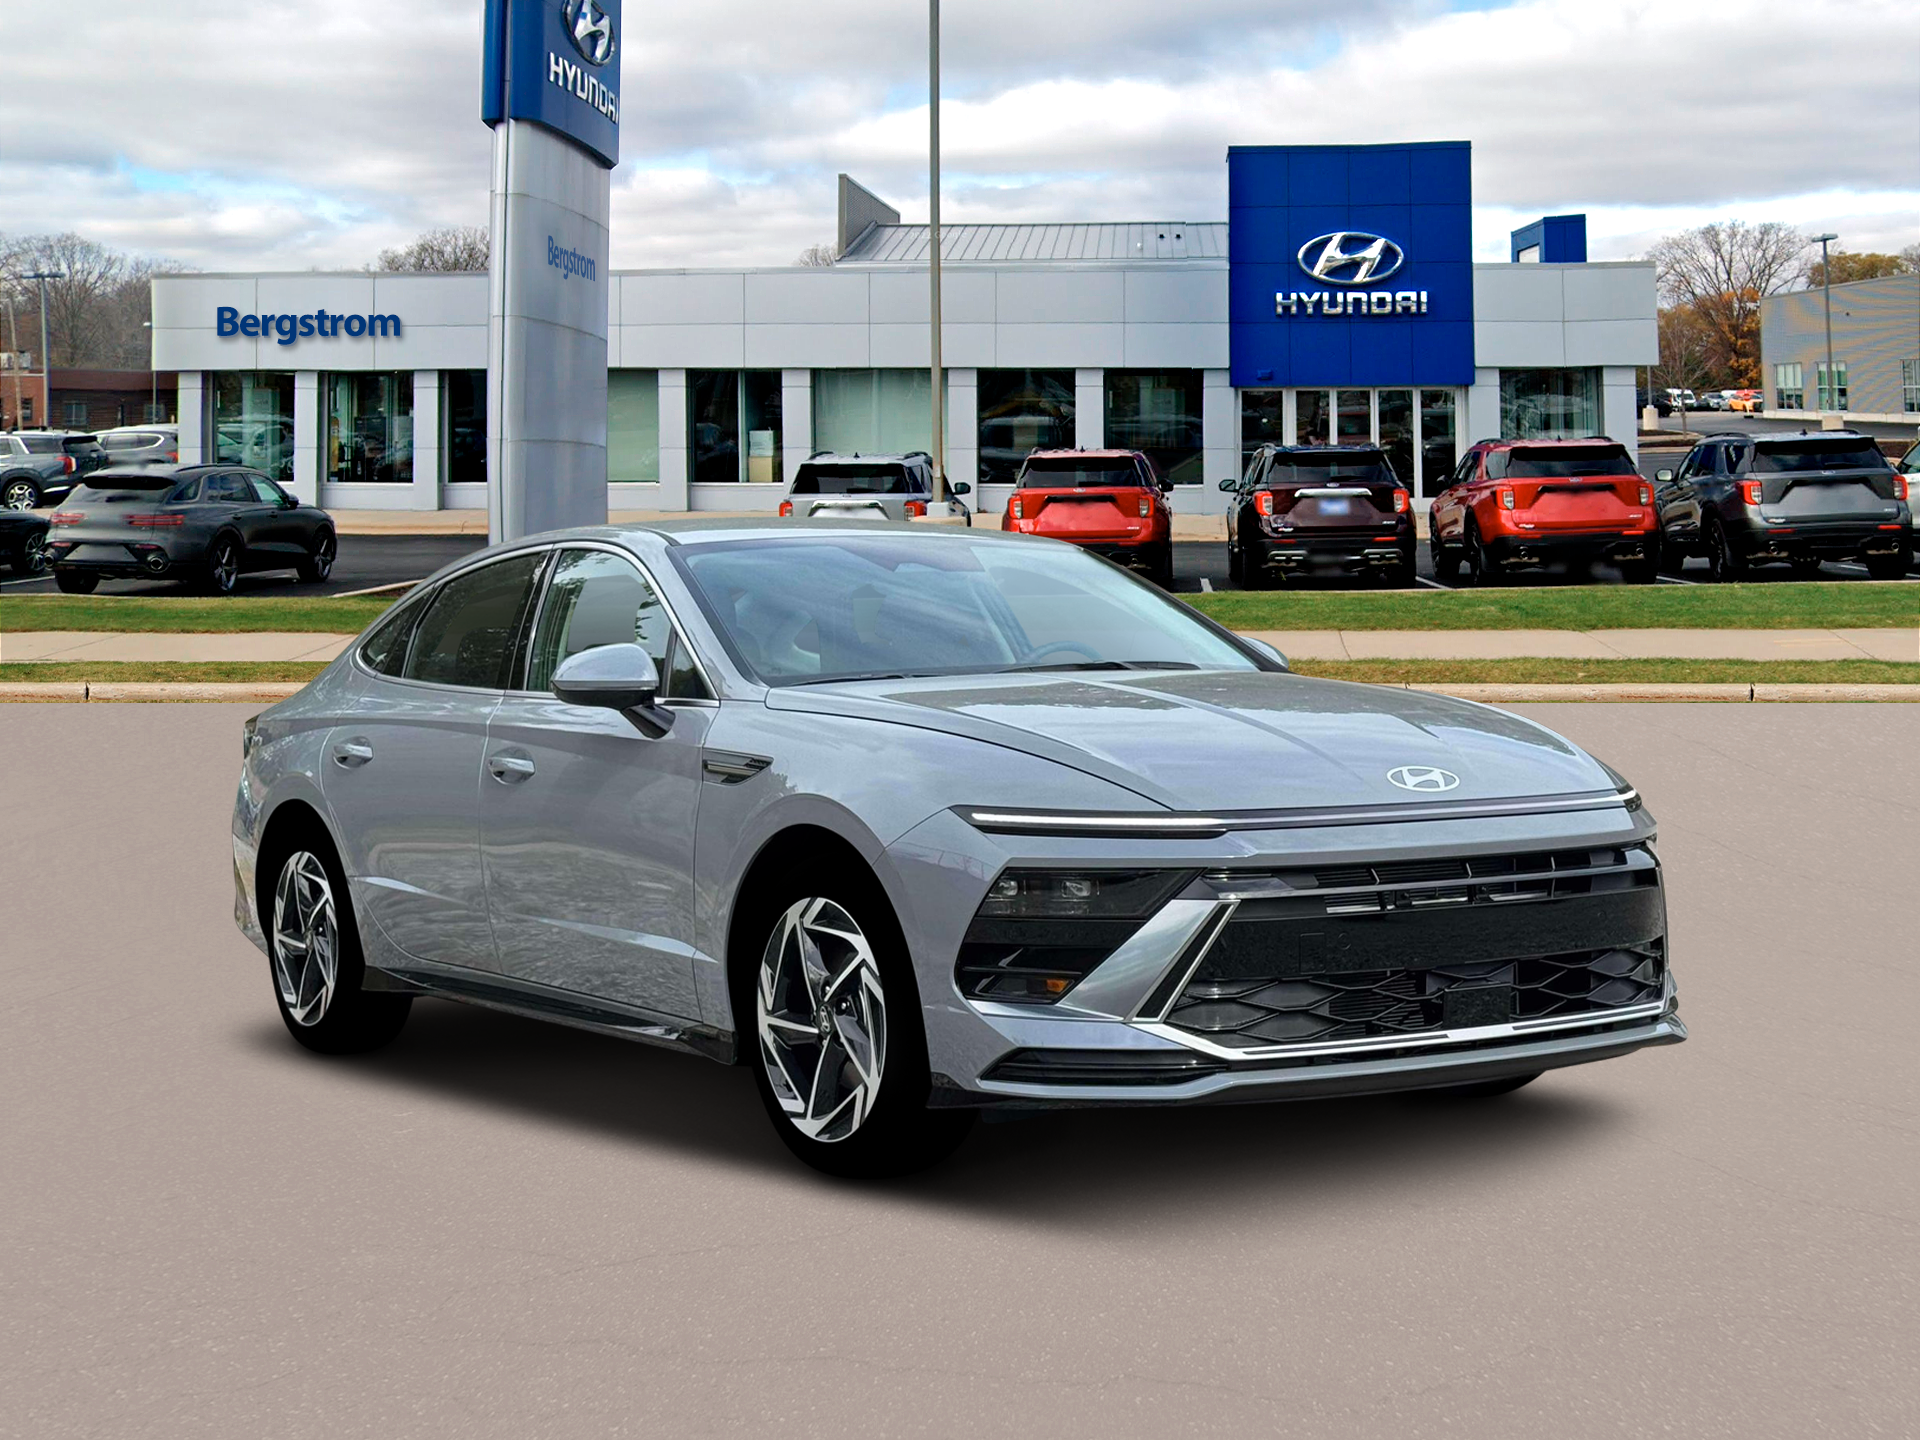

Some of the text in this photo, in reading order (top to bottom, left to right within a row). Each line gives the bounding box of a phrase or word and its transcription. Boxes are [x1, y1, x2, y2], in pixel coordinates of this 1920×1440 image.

[548, 52, 619, 124] HYUNDAI
[548, 236, 596, 281] Bergstrom
[1275, 291, 1428, 315] HYUNDAI
[217, 306, 401, 346] Bergstrom
